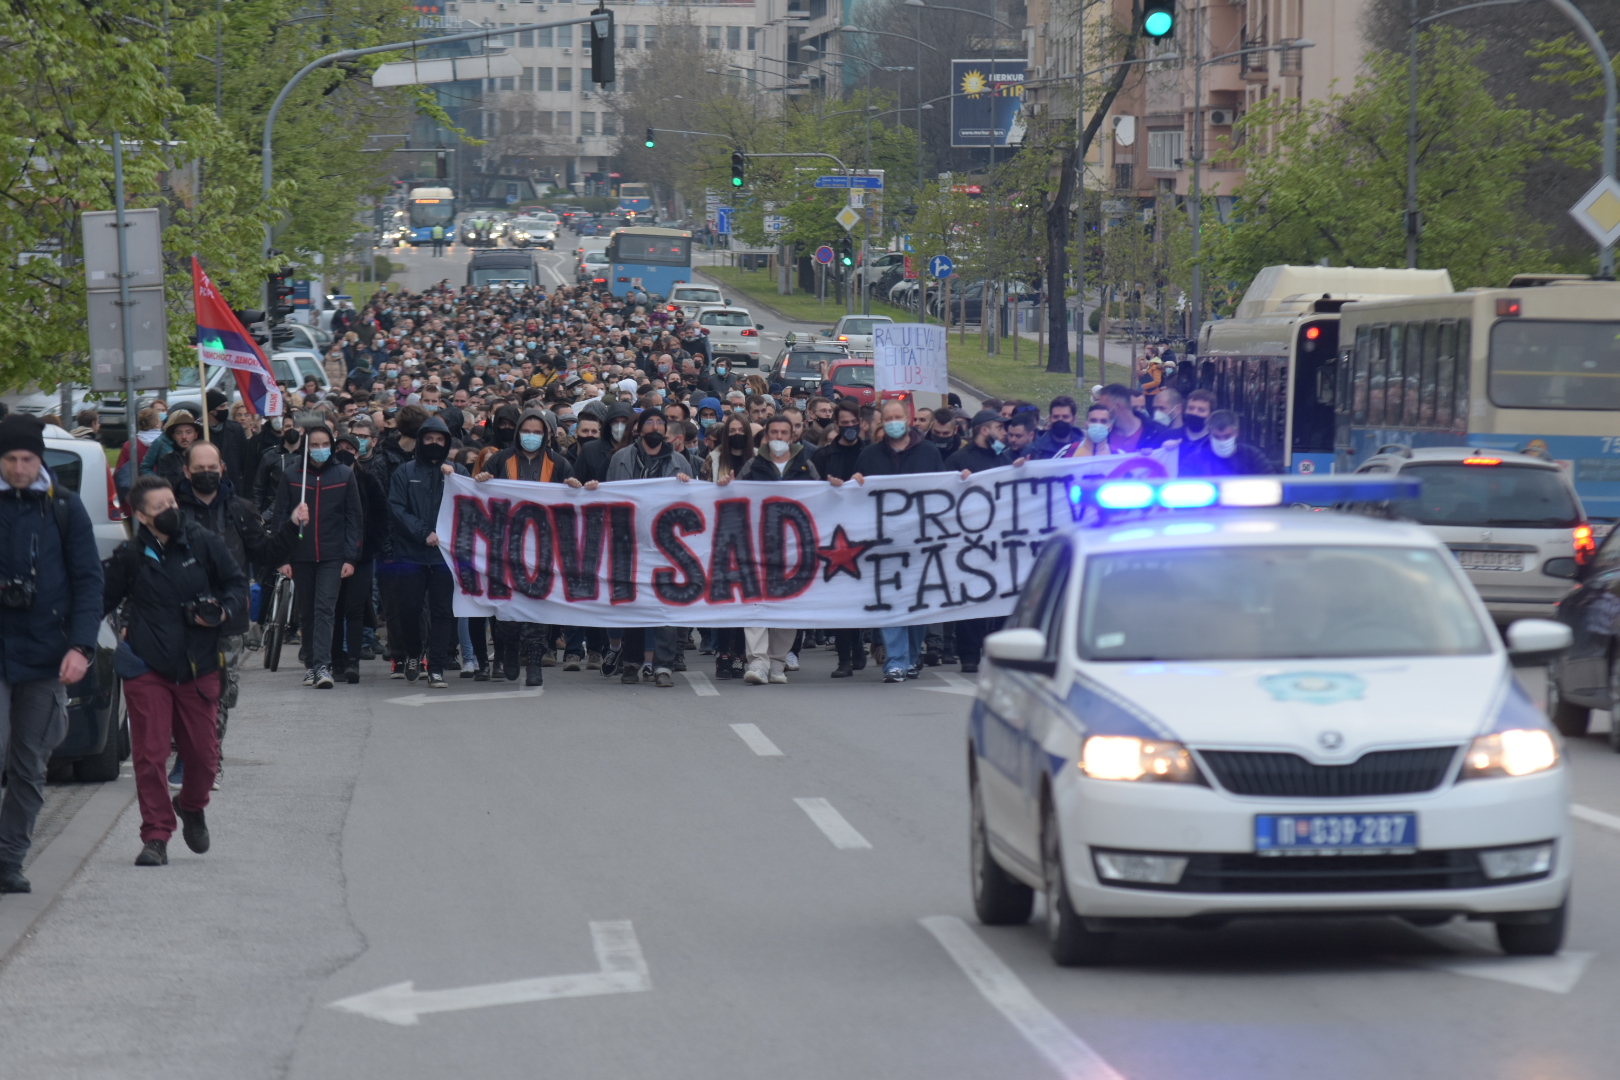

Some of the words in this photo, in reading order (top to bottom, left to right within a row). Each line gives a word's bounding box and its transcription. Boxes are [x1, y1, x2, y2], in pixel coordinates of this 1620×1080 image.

[452, 495, 637, 606] NOVI
[651, 496, 820, 606] SAD
[864, 534, 1042, 613] FAŠI
